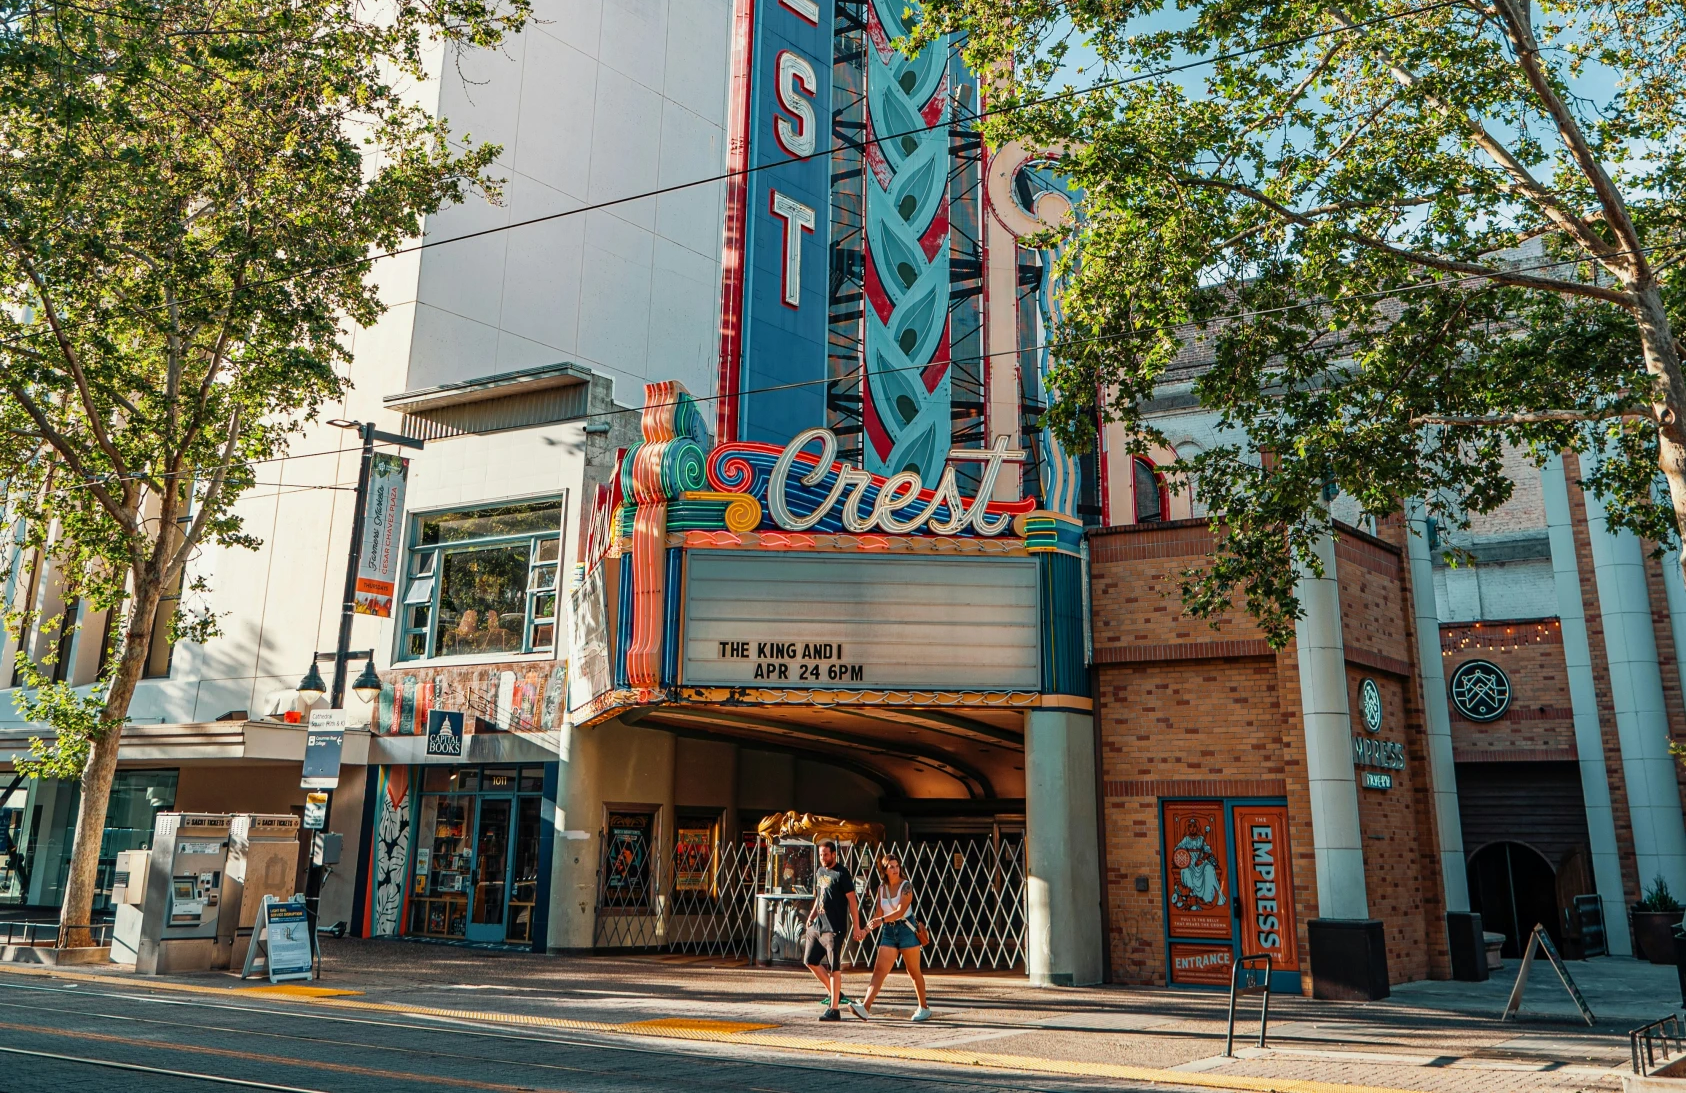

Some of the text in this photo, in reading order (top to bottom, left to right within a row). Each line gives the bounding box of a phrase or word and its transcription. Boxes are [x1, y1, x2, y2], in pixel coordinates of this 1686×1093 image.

[767, 427, 1029, 537] Crest
[382, 486, 398, 575] CESAR CHAVEZ PLAZA
[364, 583, 388, 591] THURSDAYS
[719, 642, 750, 658] THE
[757, 642, 797, 659] KING
[754, 663, 863, 681] APR 24 6PM
[429, 734, 461, 745] CAPITAL
[429, 742, 461, 754] BOOKS
[1352, 736, 1406, 770] MPRESS
[492, 776, 507, 786] 1011
[1251, 825, 1280, 949] EMPRESS
[1175, 953, 1230, 969] ENTRANCE
